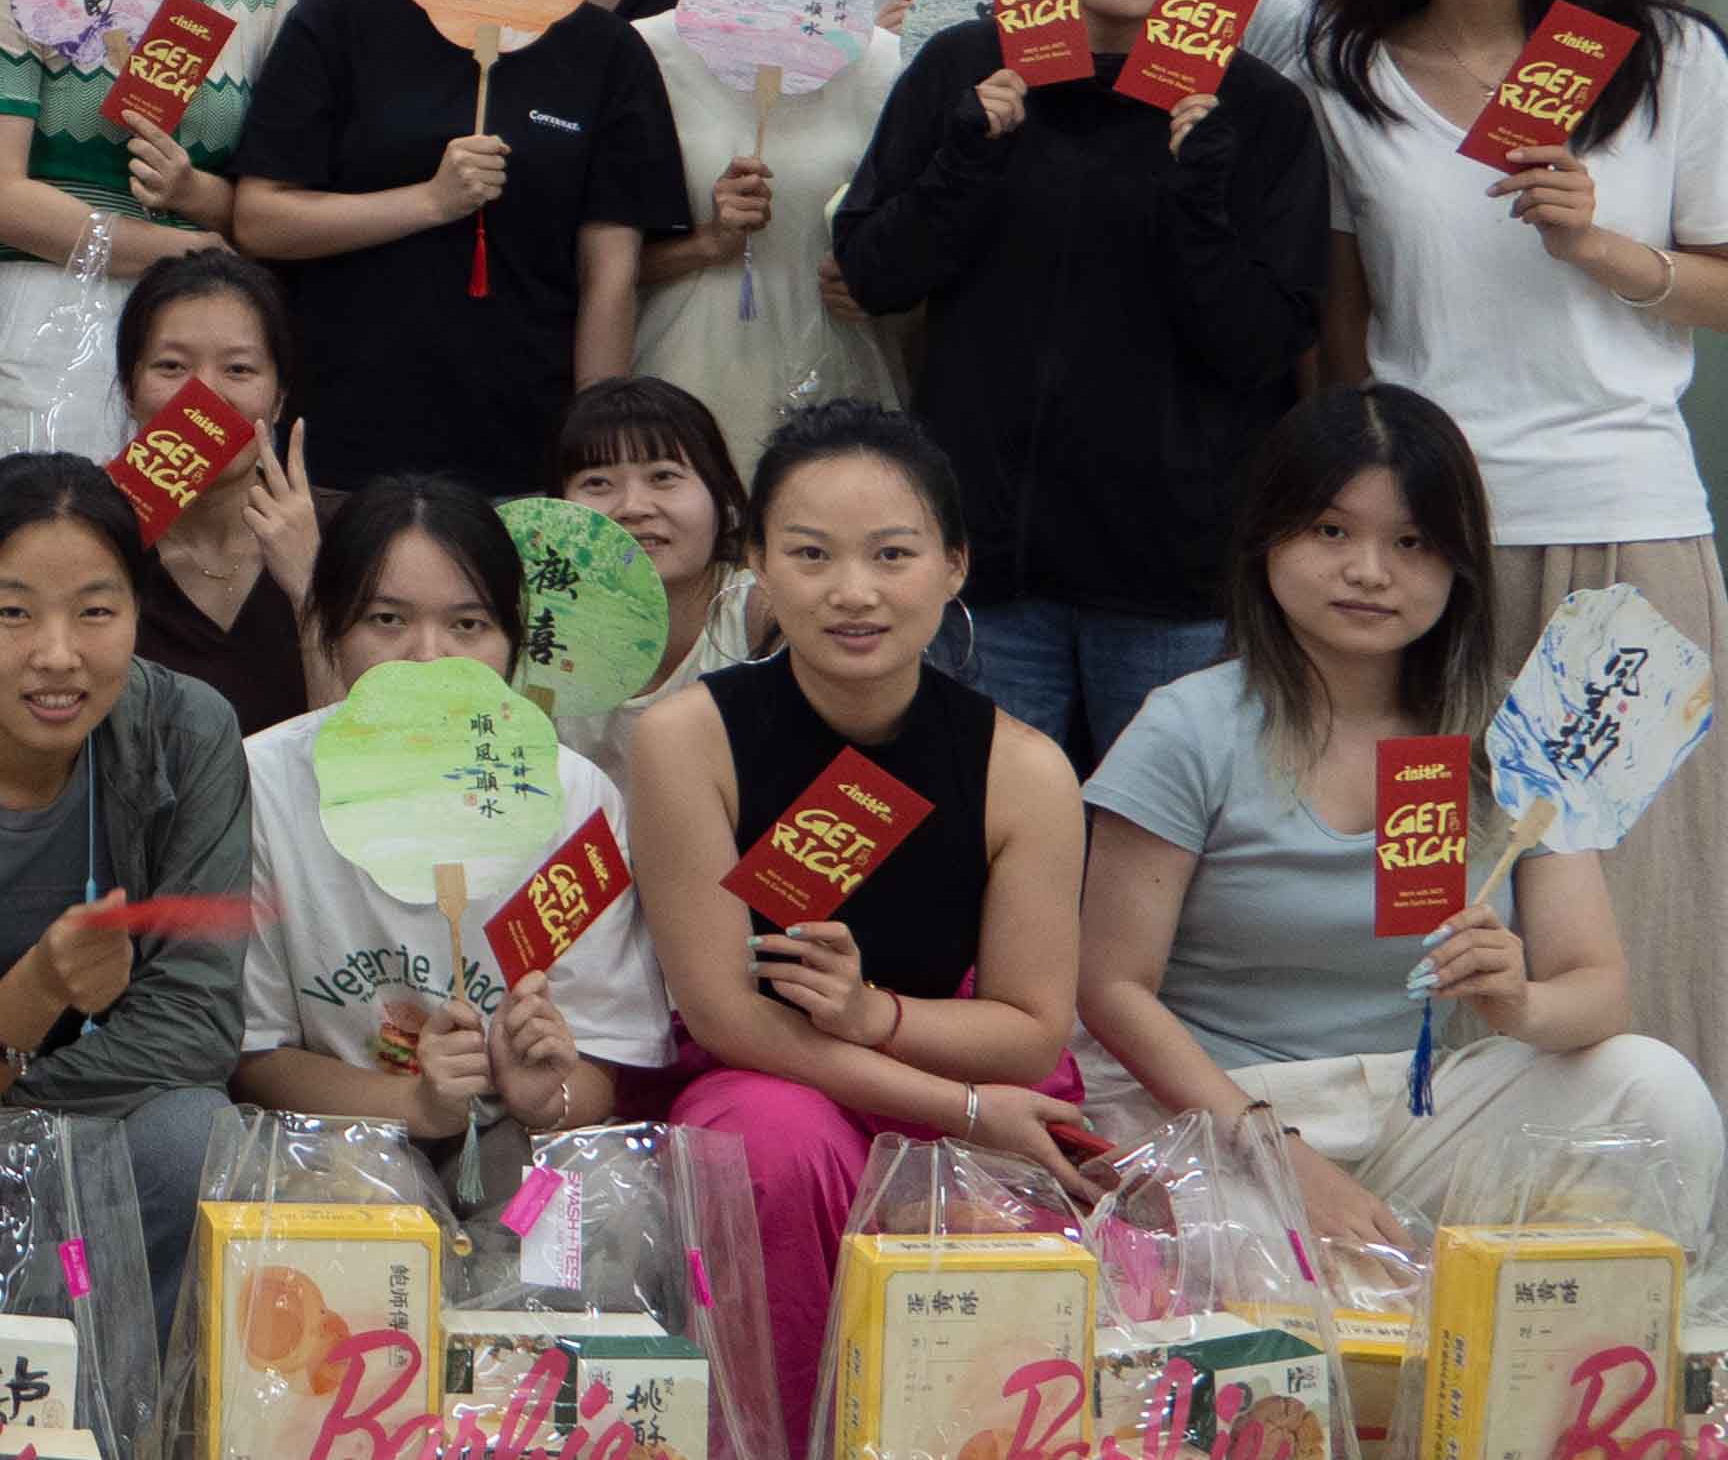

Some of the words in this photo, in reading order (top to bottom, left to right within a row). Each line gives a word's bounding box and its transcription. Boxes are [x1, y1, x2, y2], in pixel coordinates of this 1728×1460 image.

[142, 38, 202, 74] GET
[1147, 18, 1234, 67] RICH
[129, 54, 197, 103] RICH
[1517, 61, 1593, 100] GET
[1498, 82, 1584, 132] RICH
[125, 440, 197, 508] RICH
[146, 429, 210, 475] GET
[470, 713, 505, 819] 順風順水
[794, 809, 876, 858] GET
[1385, 801, 1456, 838] GET
[770, 822, 863, 894] RICH
[1377, 835, 1467, 870] RICH
[528, 871, 572, 957] RICH
[548, 863, 590, 920] GET
